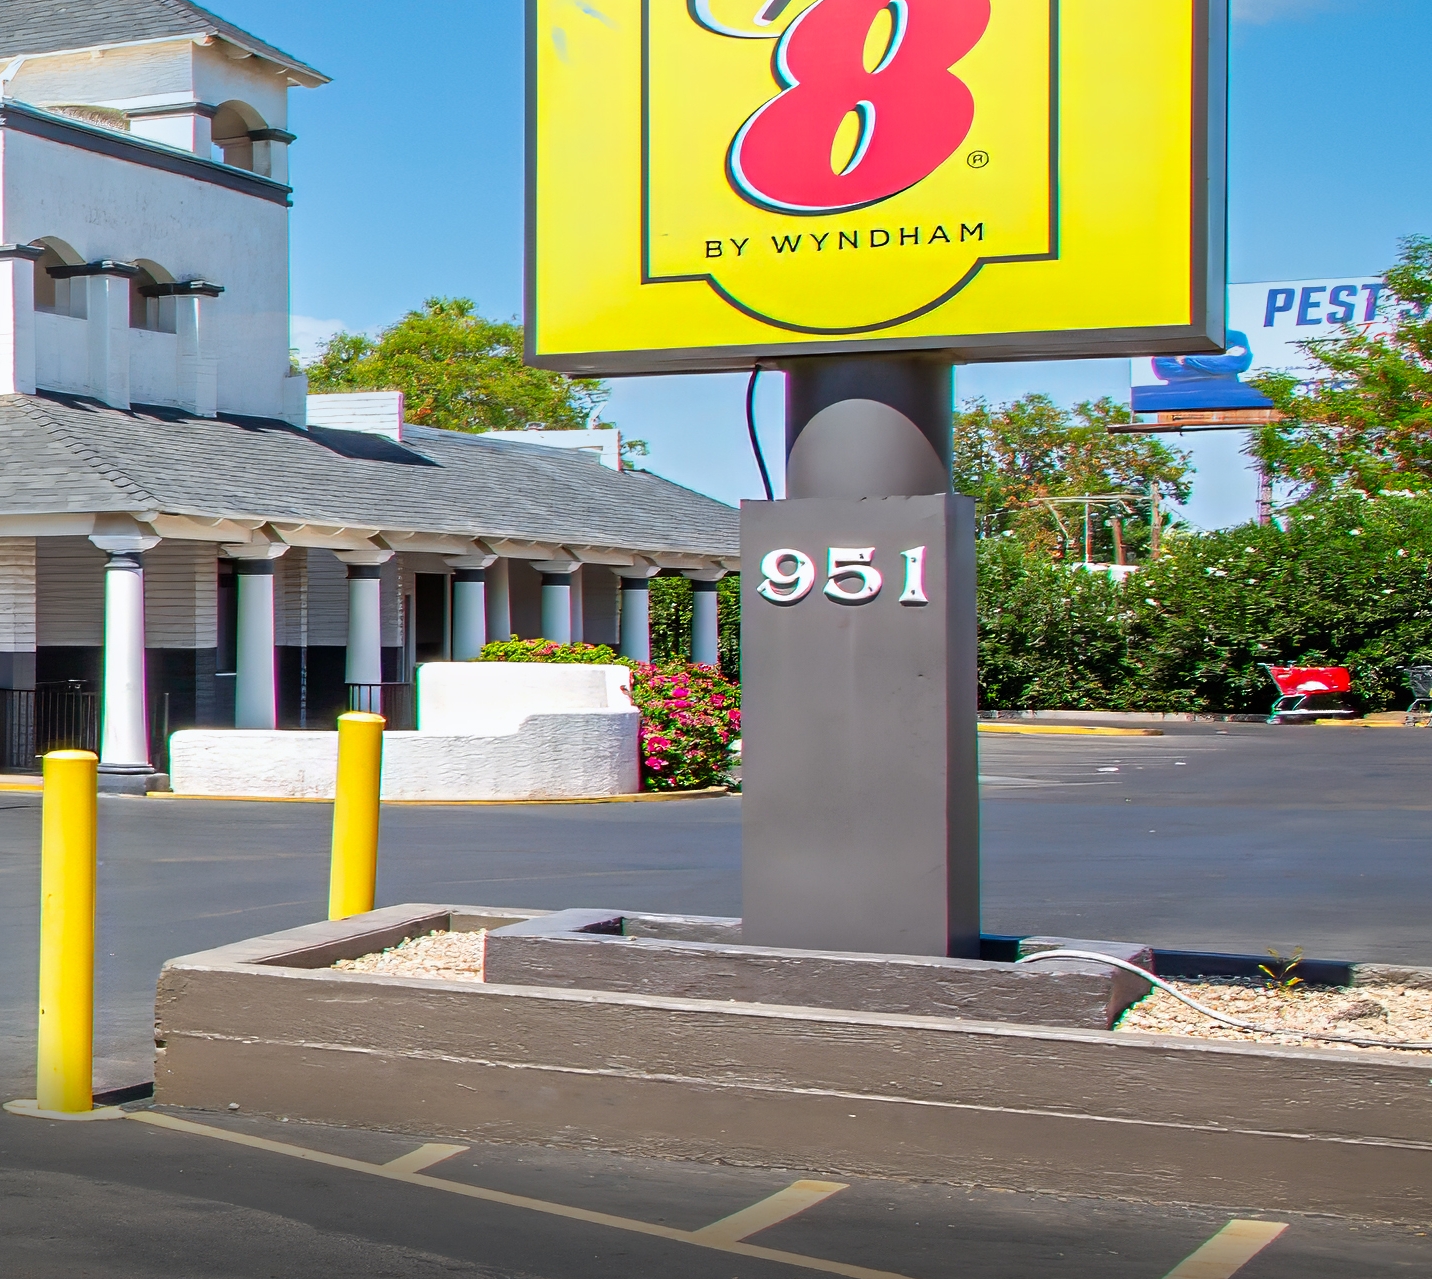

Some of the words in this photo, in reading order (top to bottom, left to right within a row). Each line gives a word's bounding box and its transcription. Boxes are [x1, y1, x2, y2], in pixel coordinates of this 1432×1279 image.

[705, 237, 750, 259] BY
[771, 222, 985, 254] WYNDHAM
[1263, 283, 1388, 328] PEST
[757, 545, 930, 606] 951
